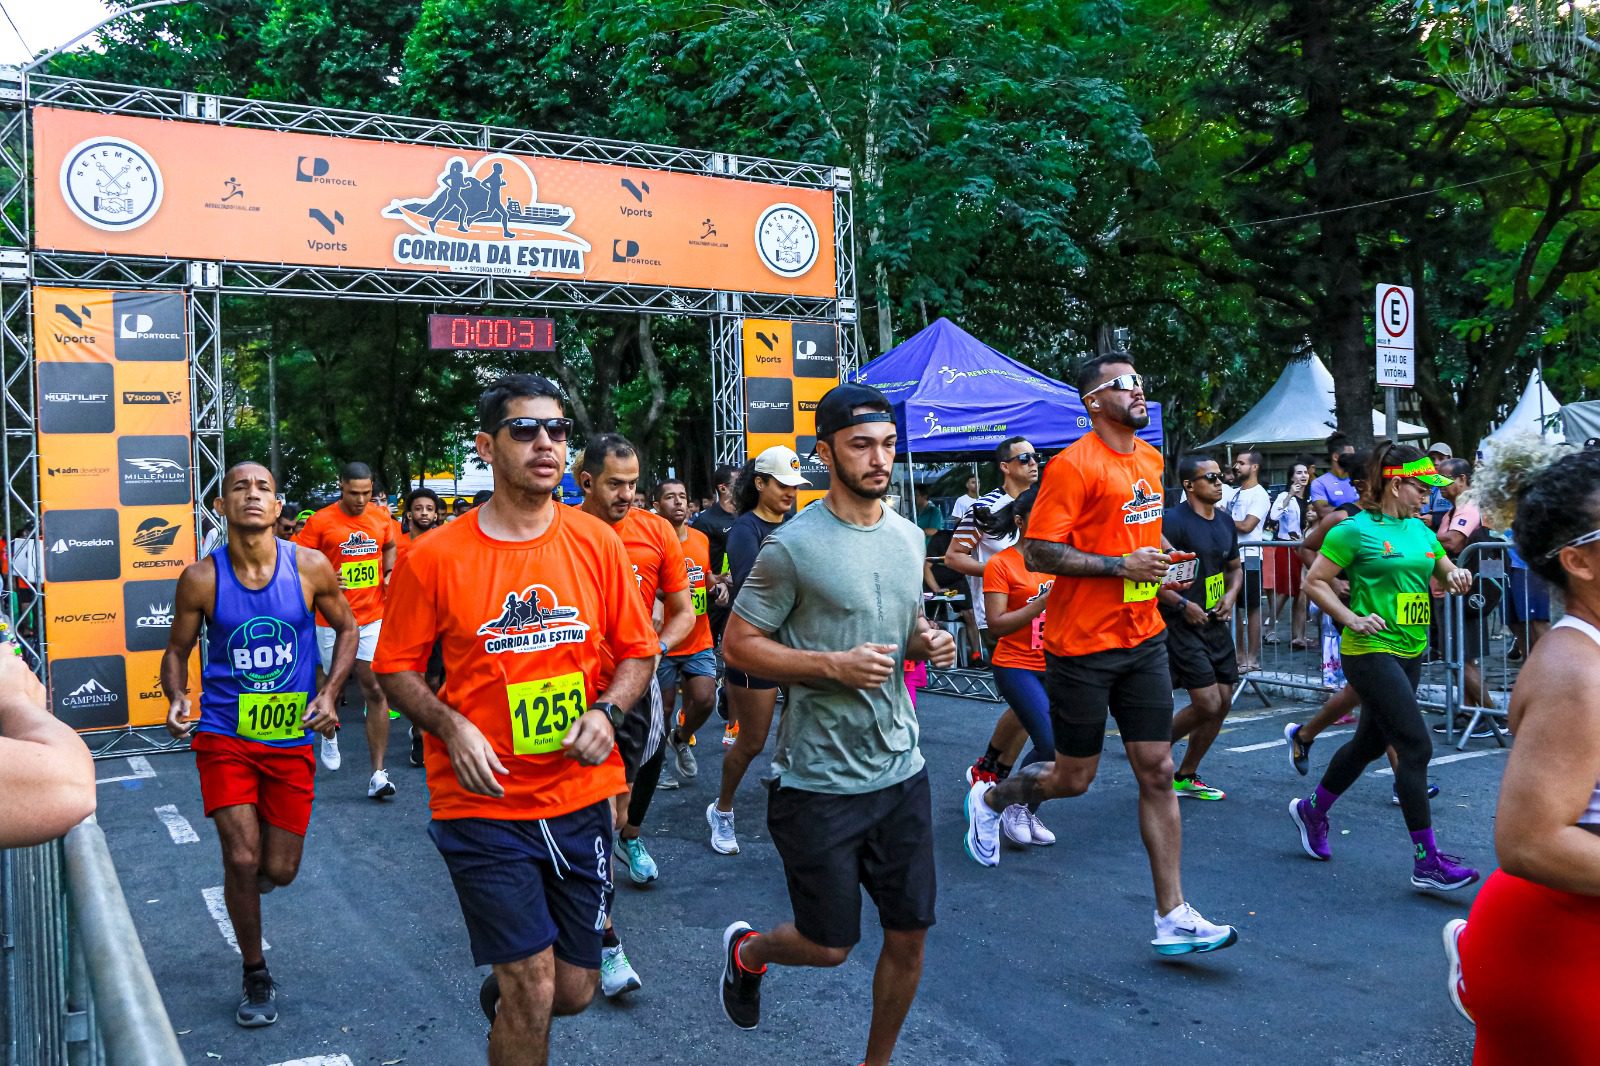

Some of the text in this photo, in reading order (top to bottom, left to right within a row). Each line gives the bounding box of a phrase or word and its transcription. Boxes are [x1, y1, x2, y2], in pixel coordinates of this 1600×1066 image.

[76, 150, 148, 182] SETEMEES
[314, 176, 358, 186] PORTOCEL
[620, 206, 652, 218] Vports
[765, 214, 810, 240] SETEMEES
[308, 240, 348, 252] Vports
[398, 238, 580, 270] CORRIDA DA ESTIVA
[1391, 299, 1400, 325] E
[54, 334, 96, 344] Vports
[452, 318, 552, 348] 0:00:31
[756, 355, 782, 364] Vports
[1384, 352, 1406, 364] TÁXI DE
[1384, 366, 1407, 378] VITÓRIA
[44, 393, 108, 402] MULTILIFT
[133, 560, 184, 568] CREDESTIVA
[347, 566, 374, 582] 1250
[692, 593, 705, 609] 31
[54, 612, 116, 623] MOVEON
[1404, 601, 1430, 624] 1026
[487, 629, 584, 652] CORRIDA DA ESTIVA
[233, 642, 292, 669] BOX
[254, 681, 274, 690] 027
[62, 694, 118, 706] CAMPINHO
[248, 703, 297, 730] 1003
[514, 688, 584, 738] 1253
[534, 736, 554, 745] Rafael
